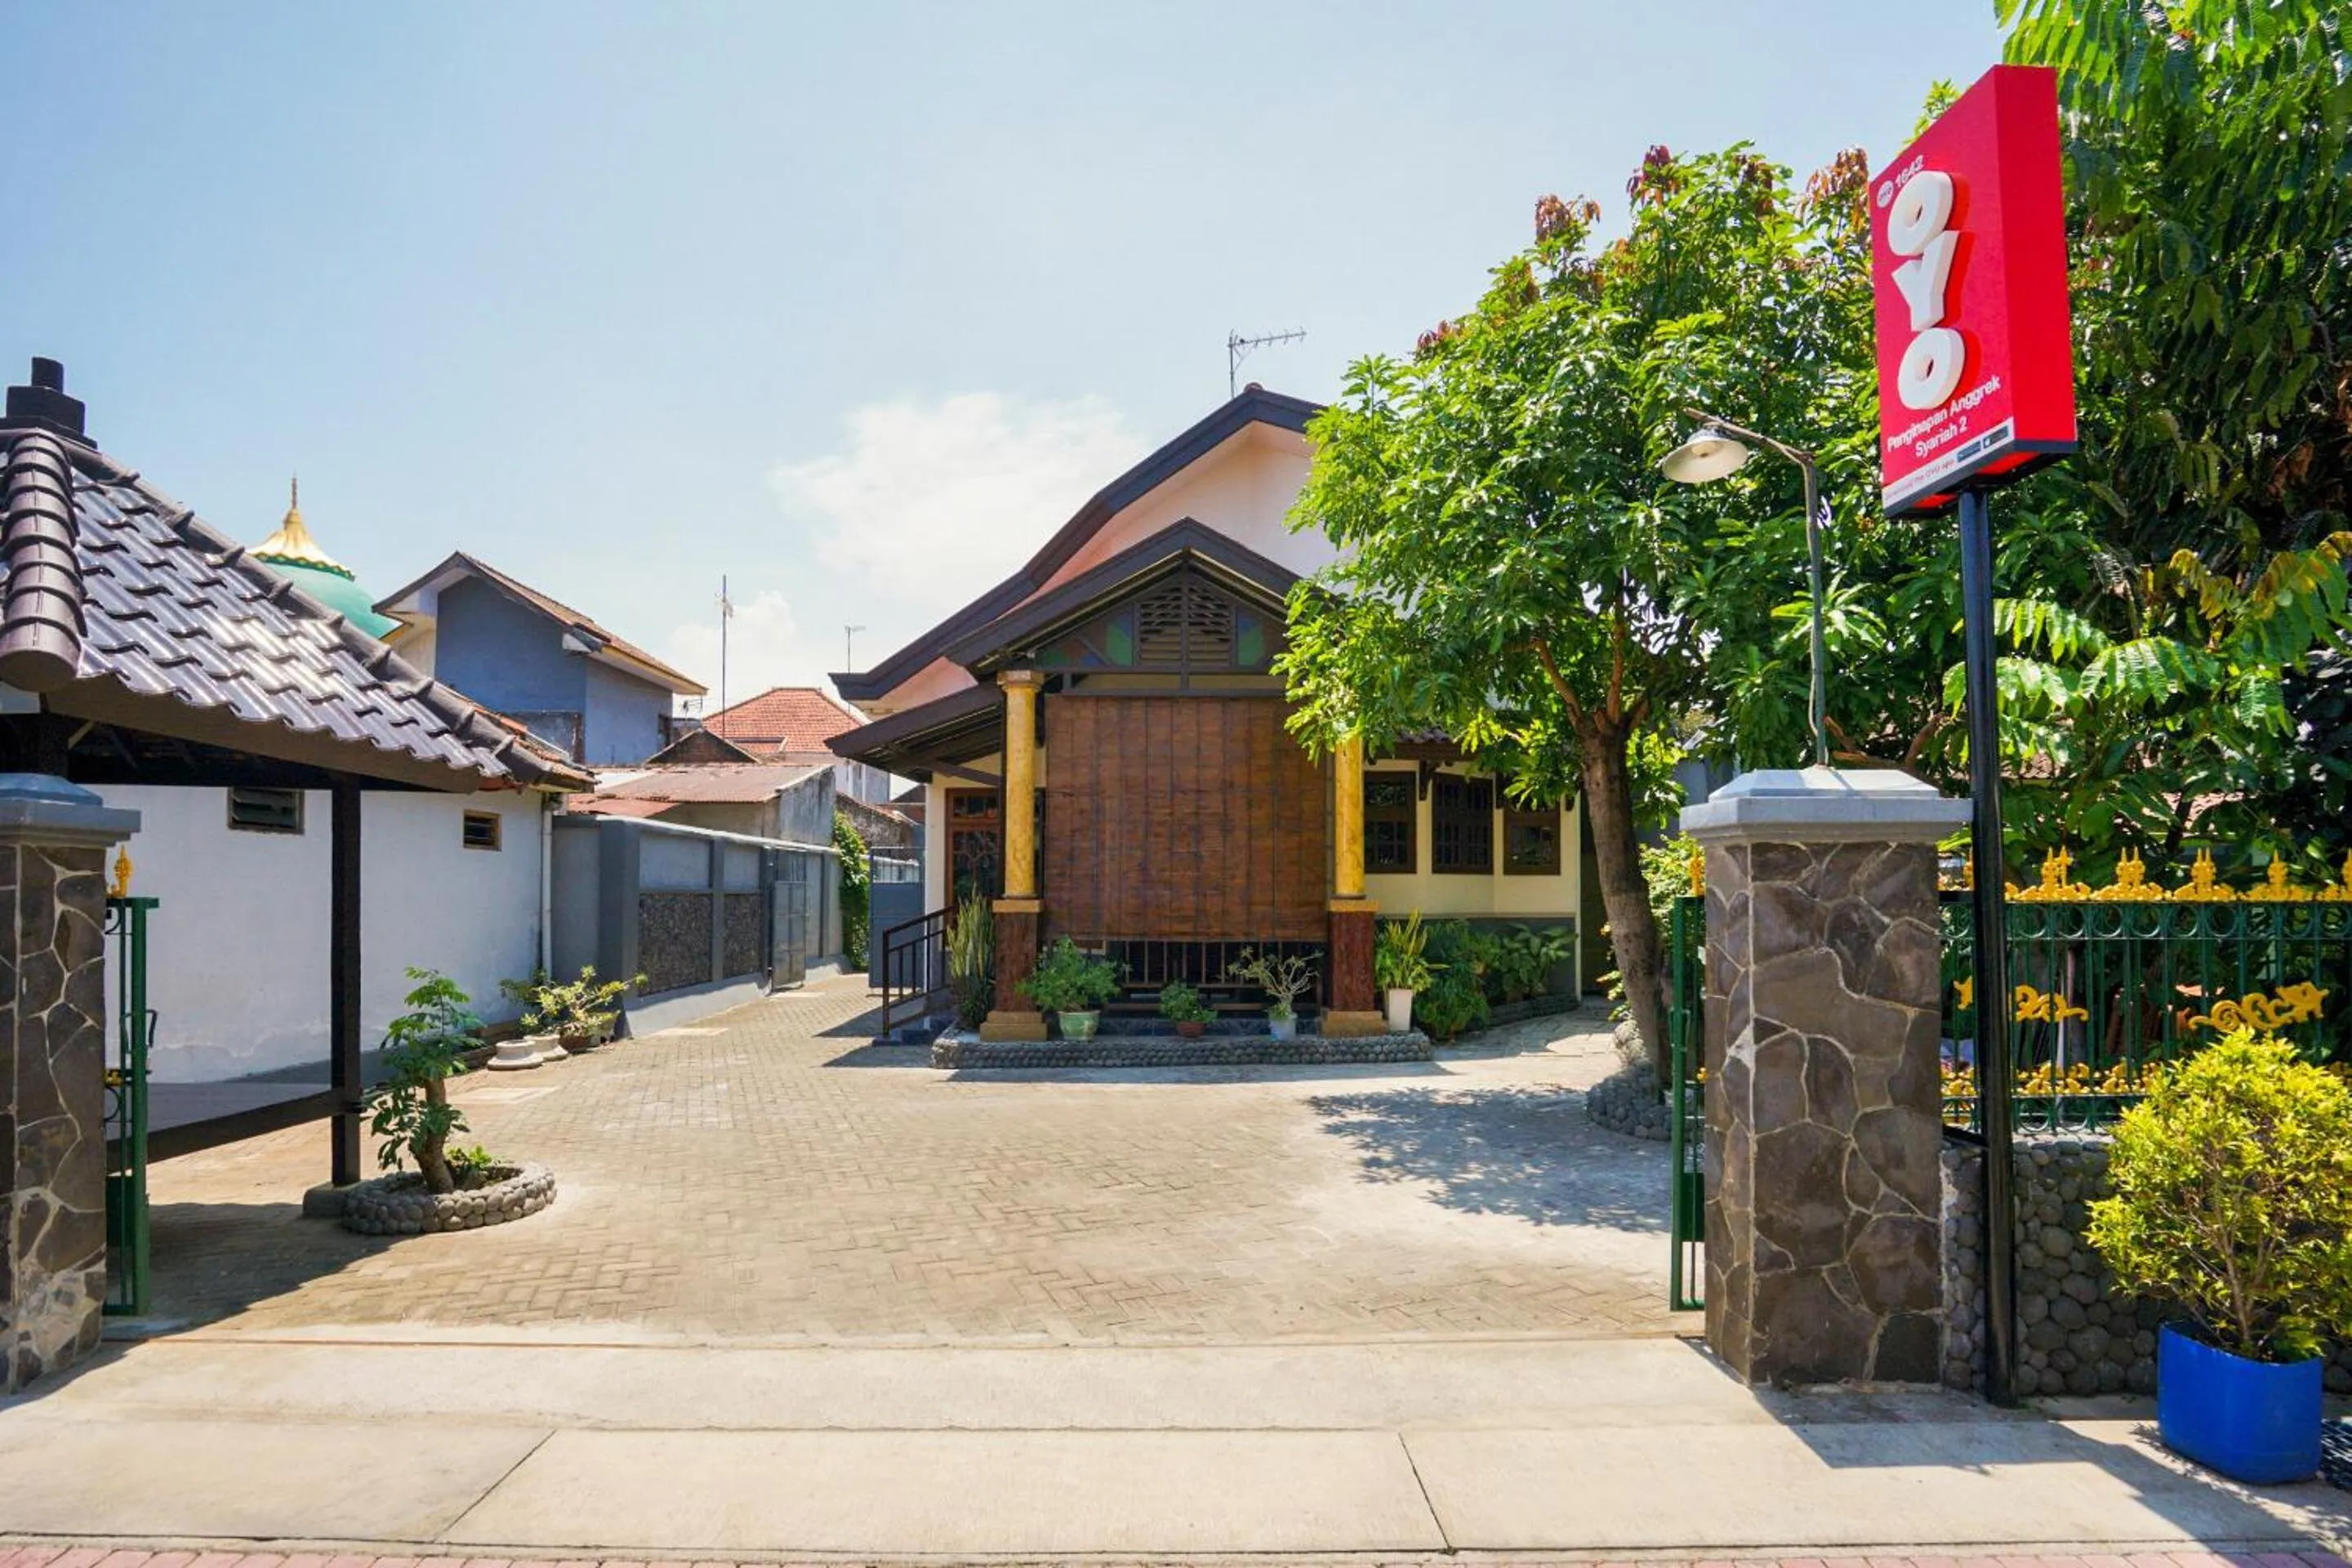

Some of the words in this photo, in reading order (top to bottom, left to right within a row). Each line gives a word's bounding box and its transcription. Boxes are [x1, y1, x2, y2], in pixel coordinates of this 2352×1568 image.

[1887, 170, 1966, 410] OYO
[1887, 408, 1948, 452] Penginapan
[1949, 374, 2001, 416] Anggrek
[1915, 422, 1958, 457] Syariah
[1959, 415, 1967, 434] 2
